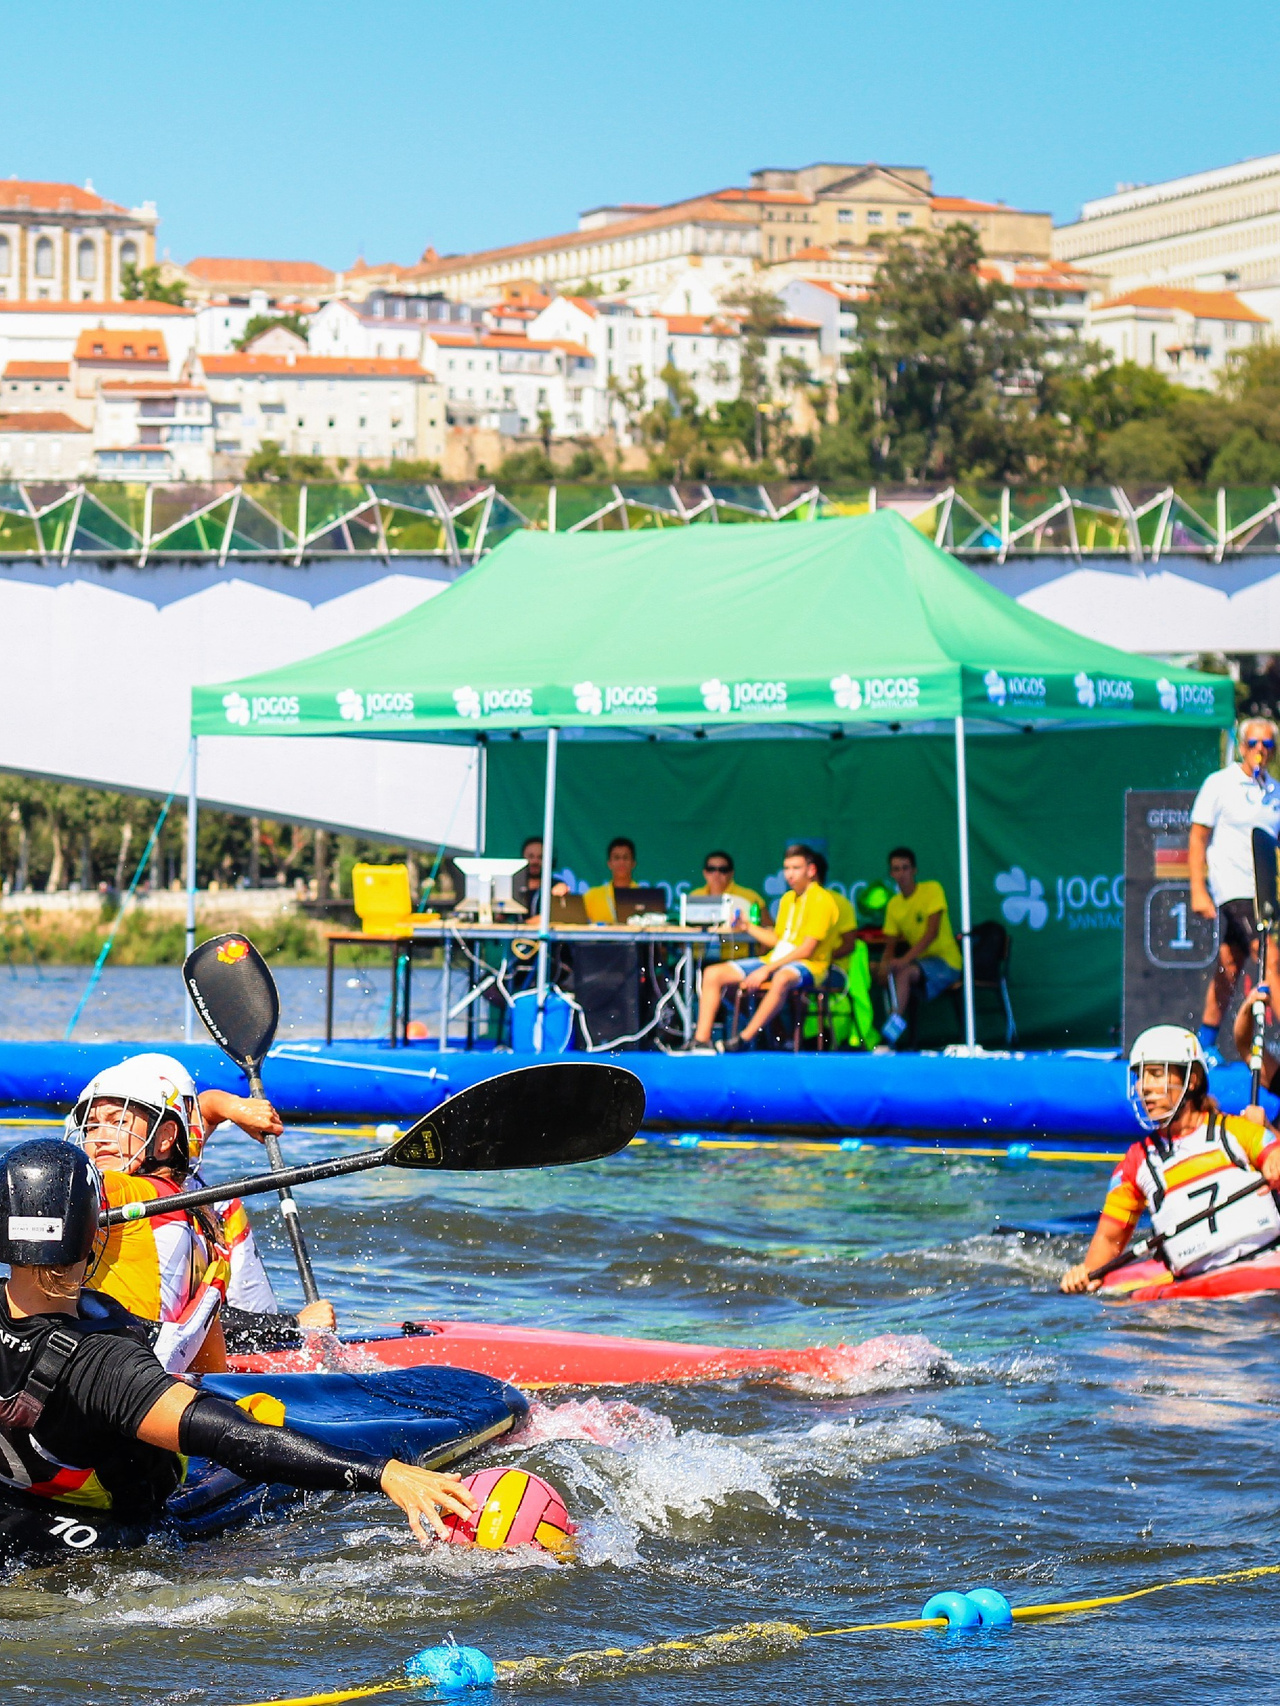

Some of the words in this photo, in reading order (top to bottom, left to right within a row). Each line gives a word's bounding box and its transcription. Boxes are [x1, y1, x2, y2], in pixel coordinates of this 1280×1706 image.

[483, 688, 533, 713] JOGOS
[605, 686, 658, 711] JOGOS
[734, 682, 788, 709] JOGOS
[864, 677, 920, 705] JOGOS
[1097, 679, 1134, 700] JOGOS
[1180, 685, 1215, 705] JOGOS
[252, 696, 300, 720] JOGOS
[366, 692, 415, 717] JOGOS
[1149, 809, 1192, 826] GERM
[1056, 875, 1125, 920] JOGO
[1170, 902, 1194, 949] 1
[1188, 1182, 1218, 1234] 7
[49, 1516, 98, 1548] 10
